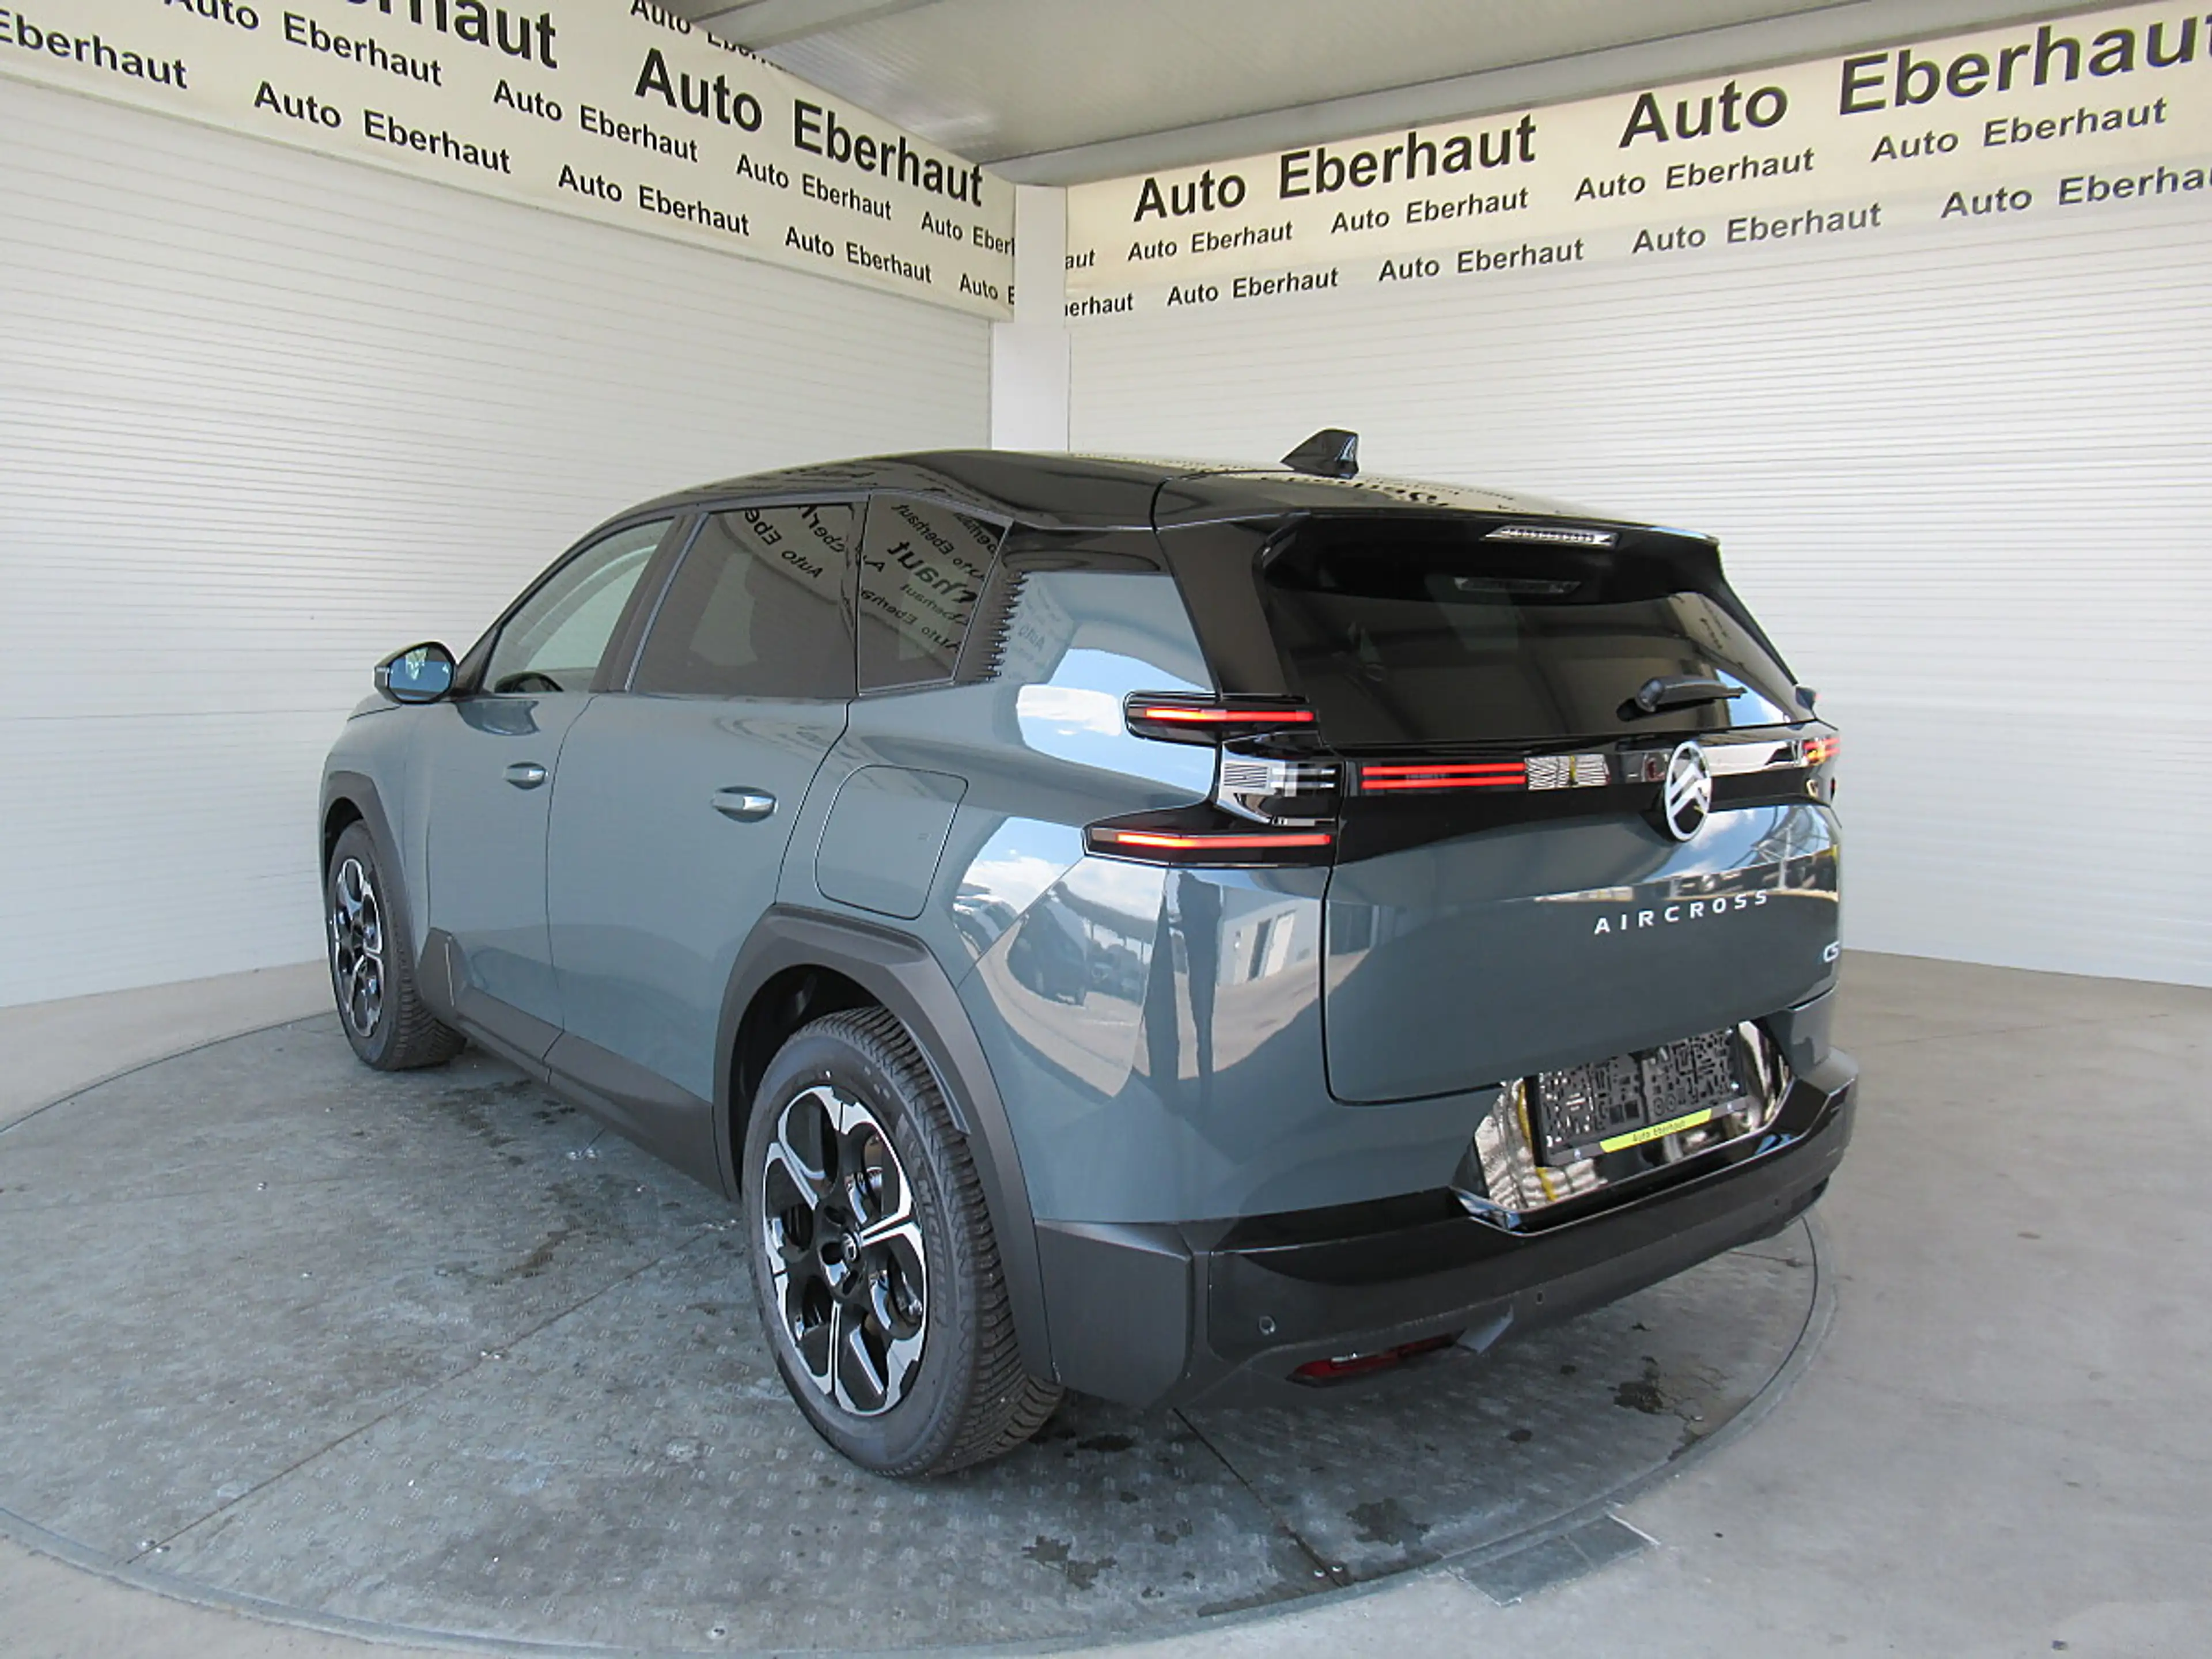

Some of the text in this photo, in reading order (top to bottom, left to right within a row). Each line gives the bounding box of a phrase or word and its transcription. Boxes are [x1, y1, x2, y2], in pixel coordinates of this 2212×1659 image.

[282, 10, 442, 87] Eberhaut
[254, 81, 511, 174] Auto Eberhaut
[494, 79, 698, 163] Auto Eberhaut
[635, 48, 763, 132] Auto
[794, 99, 982, 207] Eberhaut
[1619, 81, 1787, 148] Auto
[1872, 97, 2167, 162] Auto Eberhaut
[736, 154, 892, 221] Auto Eberhaut
[1134, 114, 1537, 222] Auto Eberhaut
[1575, 148, 1815, 201] Auto Eberhaut
[1941, 166, 2212, 218] Auto Eberha
[558, 164, 750, 237] Auto Eberhaut
[921, 211, 963, 241] Auto
[1331, 188, 1528, 233] Auto Eberhaut
[785, 226, 931, 283] Auto Eberhaut
[1127, 221, 1293, 262] Auto Eberhaut
[1633, 203, 1881, 253] Auto Eberhaut
[1378, 238, 1584, 281] Auto Eberhaut
[960, 273, 999, 300] Auto
[1065, 293, 1133, 317] erhaut
[1167, 268, 1338, 306] Auto Eberhaut
[1593, 889, 1767, 935] AIRCROSS
